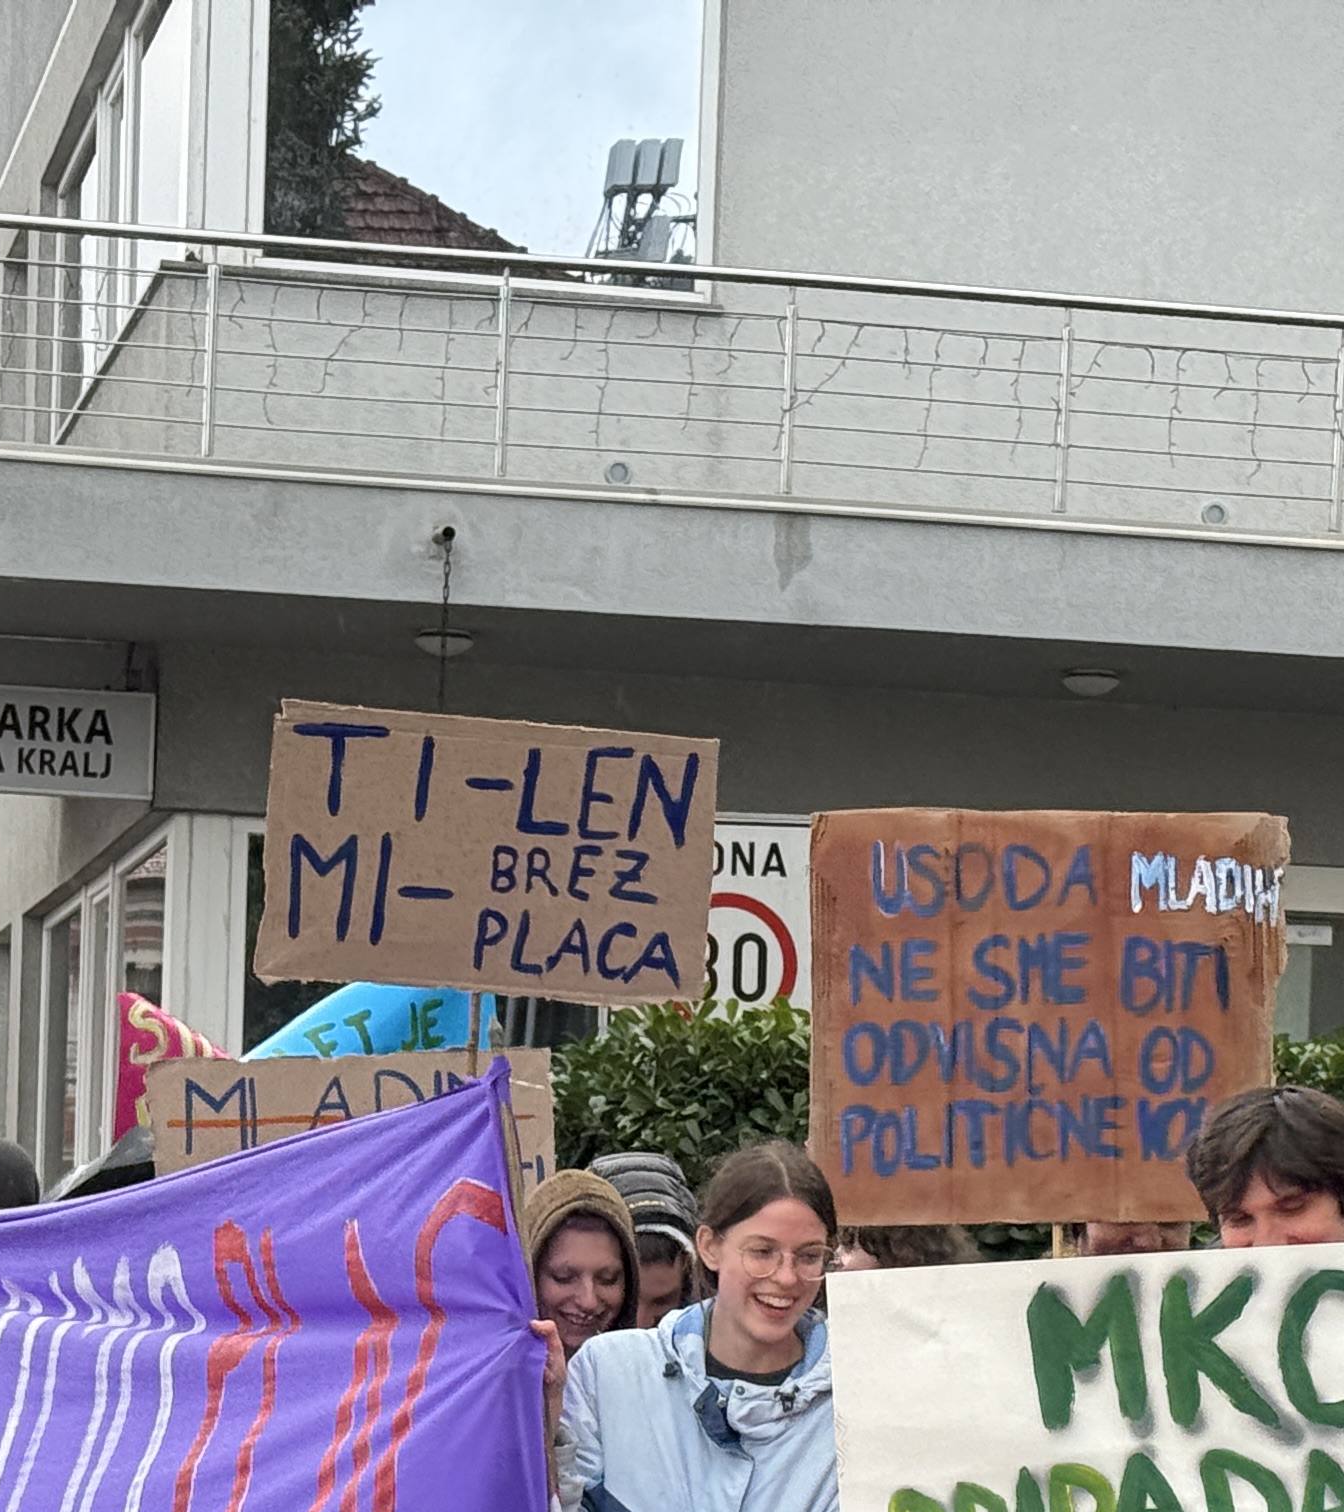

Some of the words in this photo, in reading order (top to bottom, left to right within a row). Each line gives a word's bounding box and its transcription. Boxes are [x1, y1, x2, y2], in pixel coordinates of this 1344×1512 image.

[16, 746, 113, 780] KRALJ
[490, 844, 659, 904] BREZ
[870, 838, 1099, 918] USODA
[472, 906, 681, 990] PLACA
[847, 937, 942, 1007] NE
[966, 930, 1093, 1011] SME
[1120, 934, 1231, 1016] BITI
[400, 997, 447, 1052] JE
[840, 1015, 1113, 1094] ODVISNA
[1138, 1025, 1215, 1094] OD
